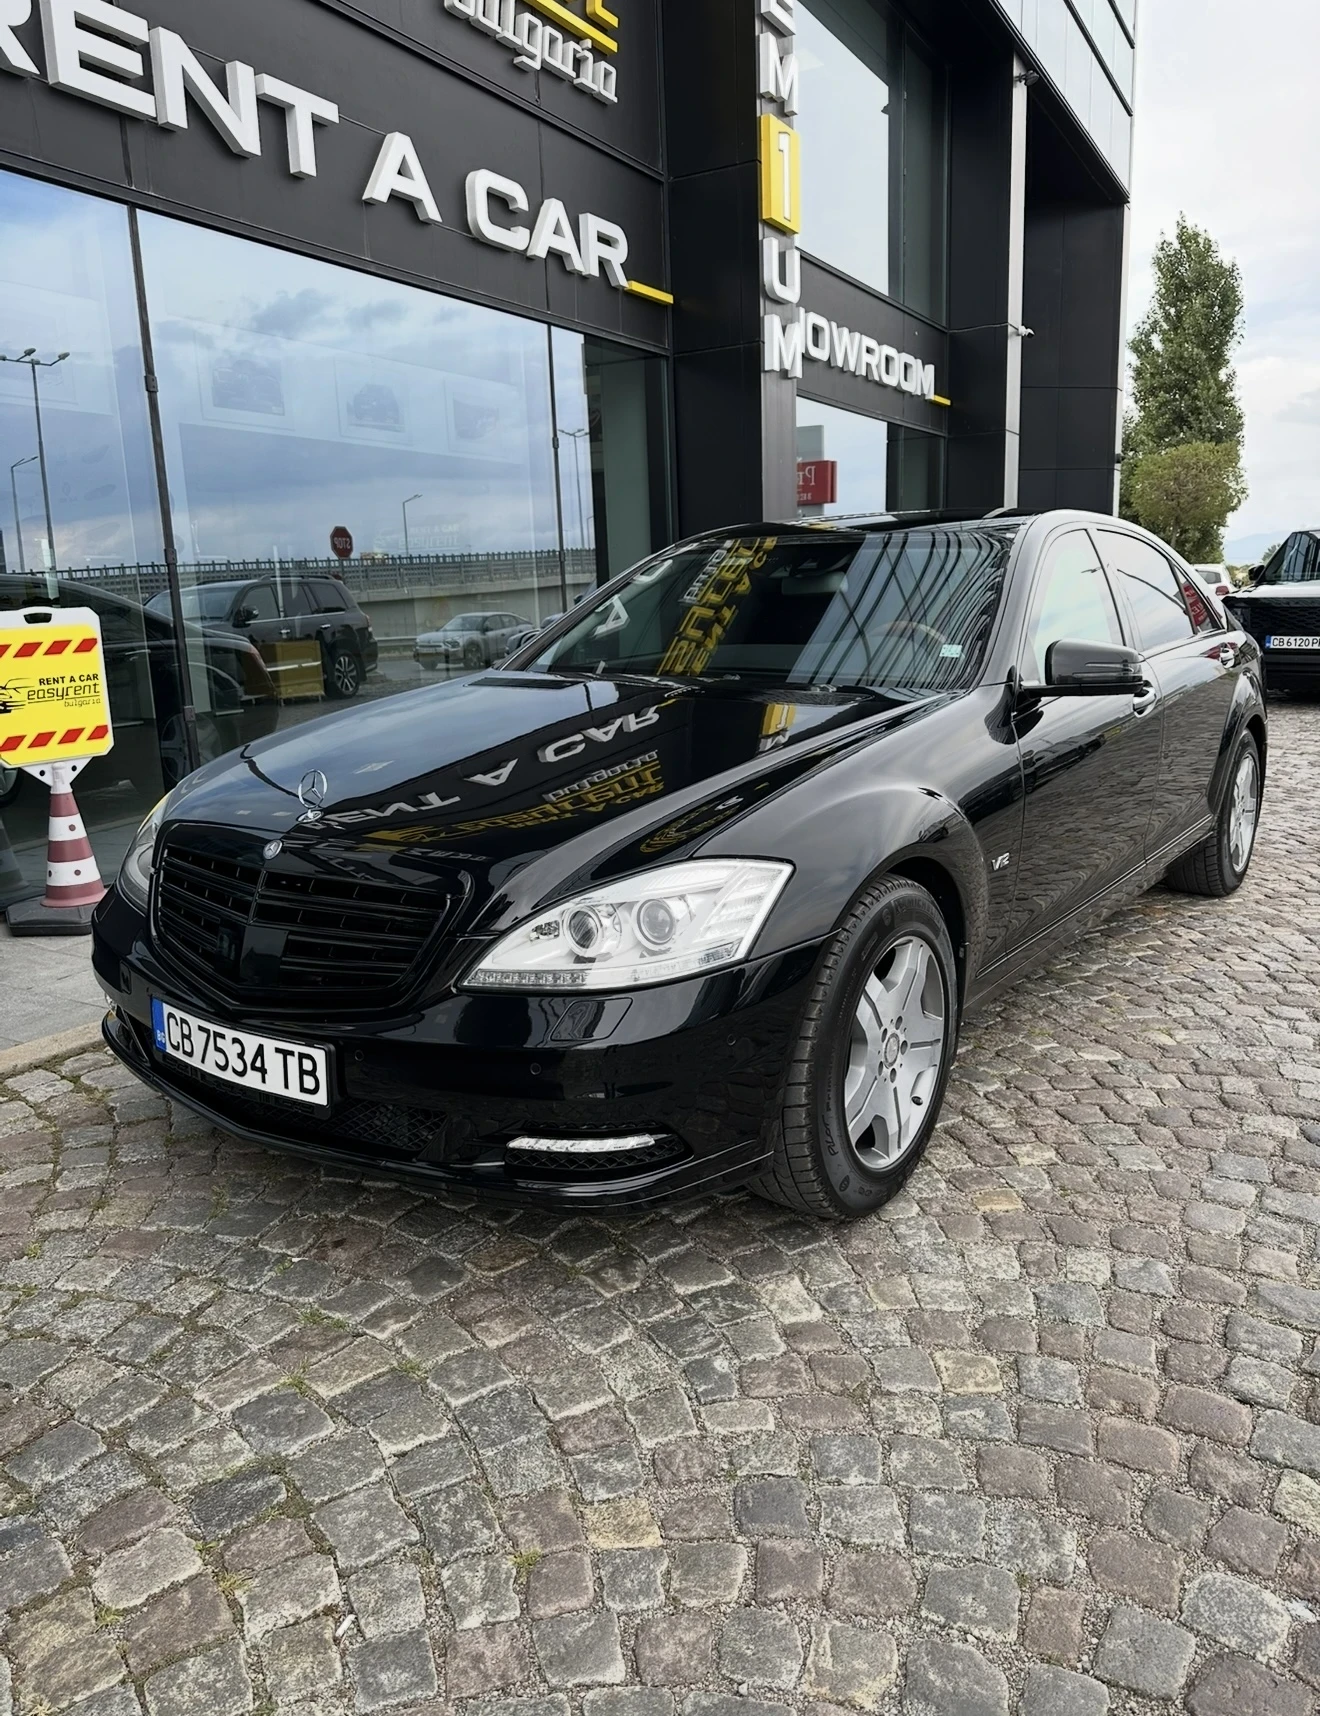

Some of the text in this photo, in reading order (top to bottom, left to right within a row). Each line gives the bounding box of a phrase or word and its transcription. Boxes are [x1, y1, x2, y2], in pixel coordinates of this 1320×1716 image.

[362, 131, 442, 223] A
[465, 168, 629, 288] CAR
[800, 306, 935, 400] OWROOM
[1272, 637, 1285, 647] CB
[1286, 637, 1310, 647] 6120
[38, 673, 99, 686] RENT A CAR
[27, 682, 100, 702] easyrent
[156, 1029, 166, 1044] BG
[166, 1011, 194, 1059] CB
[197, 1024, 269, 1085] 7534
[274, 1046, 320, 1096] TB
